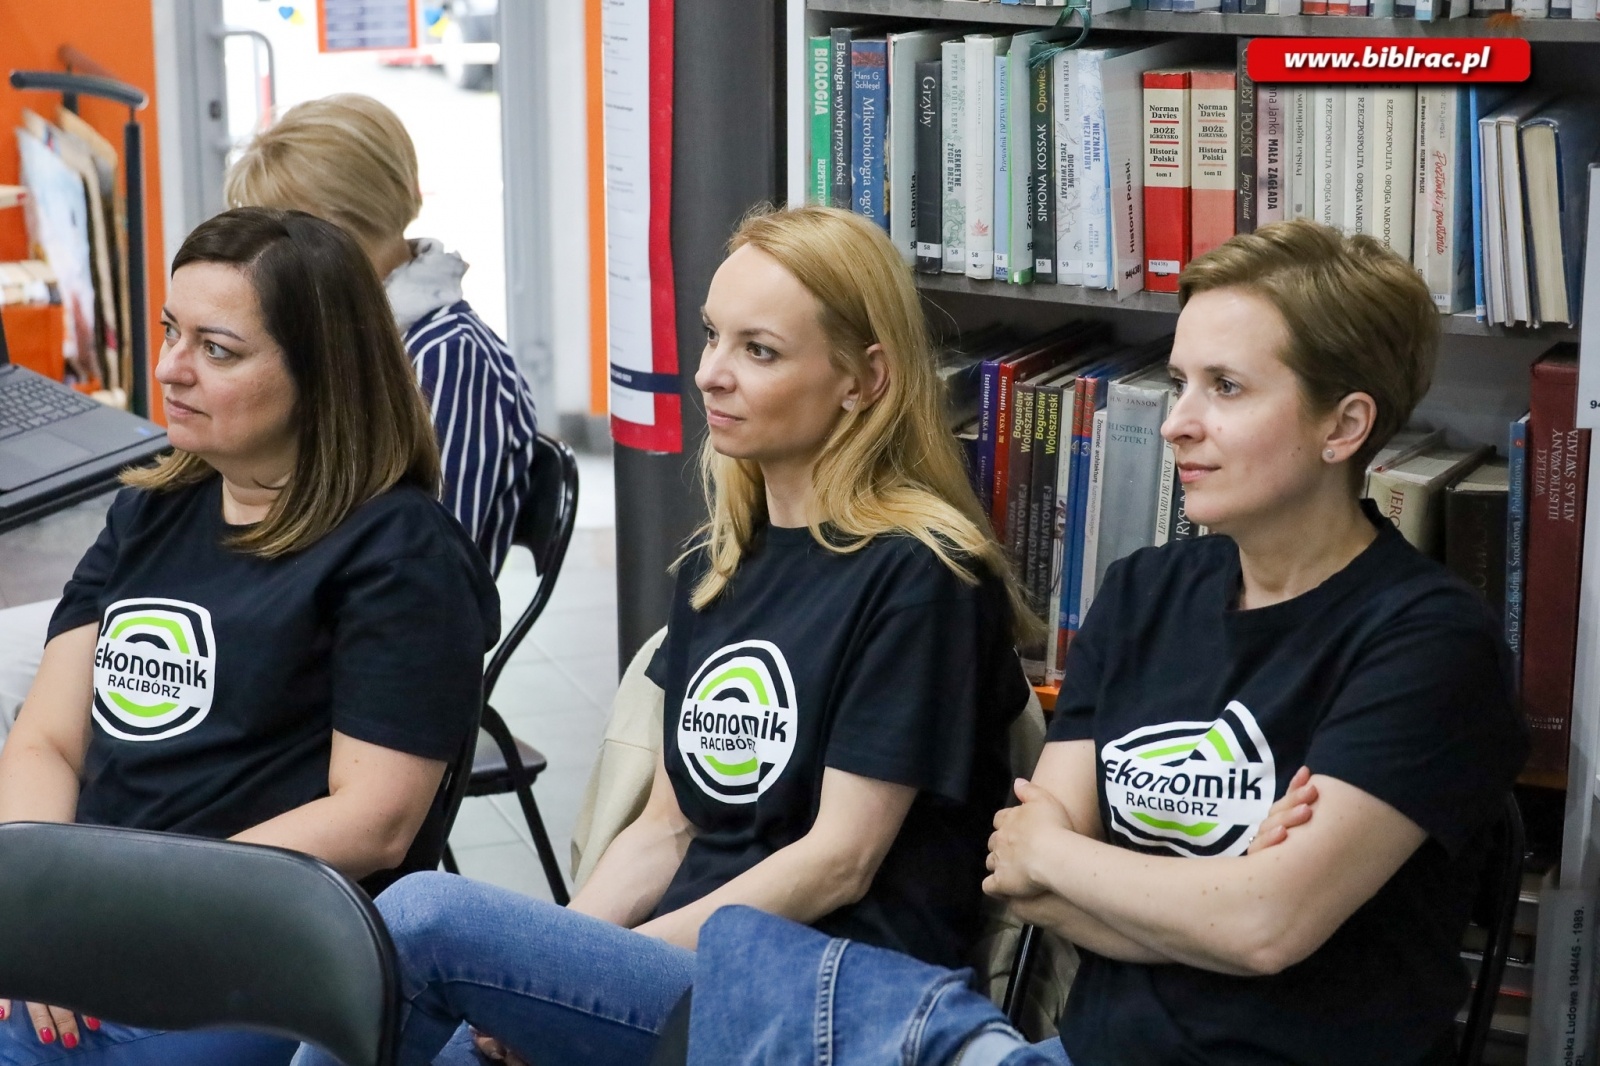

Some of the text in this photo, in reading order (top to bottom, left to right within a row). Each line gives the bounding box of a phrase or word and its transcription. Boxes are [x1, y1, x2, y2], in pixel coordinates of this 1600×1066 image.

[814, 47, 829, 116] BIOLOGIA
[854, 71, 881, 80] Hans G.
[855, 80, 880, 91] Schlegel
[919, 75, 936, 128] Grzyby
[1149, 104, 1179, 112] Norman
[1151, 111, 1177, 119] Davies
[859, 96, 874, 186] Mikrobiologia
[1153, 126, 1176, 134] BOŻE
[1202, 125, 1225, 133] BOŻE
[1241, 112, 1254, 158] POLSKI
[1268, 107, 1280, 136] Janko
[1325, 97, 1333, 169] RZECZPOSPOLITA
[1356, 97, 1365, 169] RZECZPOSPOLITA
[1385, 99, 1394, 171] RZECZPOSPOLITA
[834, 129, 846, 186] przyszłości
[1037, 123, 1047, 171] KOSSAK
[1084, 140, 1092, 171] NATURY
[1092, 122, 1101, 163] NIEZNANE
[1268, 139, 1279, 165] MAŁA
[1296, 147, 1304, 176] Polska
[1067, 154, 1075, 189] DUCHOWE
[1241, 172, 1254, 191] Jerzy
[1267, 167, 1279, 211] ZAGŁADA
[1324, 172, 1332, 203] OBOJGA
[1355, 172, 1364, 203] OBOJGA
[1383, 174, 1393, 205] OBOJGA
[1037, 174, 1047, 222] SIMONA
[1000, 376, 1008, 411] Encyklopedia
[1127, 399, 1157, 408] JANSON
[1013, 390, 1024, 439] Bogusław
[1021, 392, 1034, 453] Wołoszański
[1035, 391, 1047, 440] Bogusław
[1045, 393, 1059, 455] Wołoszański
[1095, 418, 1104, 448] Zrozumieć
[1109, 422, 1154, 436] HISTORIA
[1111, 435, 1147, 445] SZTUKI
[1162, 482, 1170, 496] DE
[1164, 460, 1172, 483] VINCI
[1511, 458, 1522, 513] Południowa
[1536, 448, 1548, 497] WIELKI
[1548, 428, 1564, 521] ILUSTROWANY
[1564, 429, 1579, 523] ATLAS ŚWIATA
[1158, 496, 1170, 535] LEONARD
[1508, 520, 1521, 567] Środkowa
[1508, 620, 1519, 654] Afryka
[94, 641, 208, 690] ekonomik
[107, 674, 181, 700] RACIBÓRZ
[682, 703, 789, 744] ekonomik
[1104, 758, 1263, 801] ekonomik
[1125, 790, 1219, 818] RACIBÓRZ
[1572, 905, 1585, 936] 1989.
[1569, 945, 1582, 987] 1944/45
[1566, 991, 1579, 1035] Ludowa
